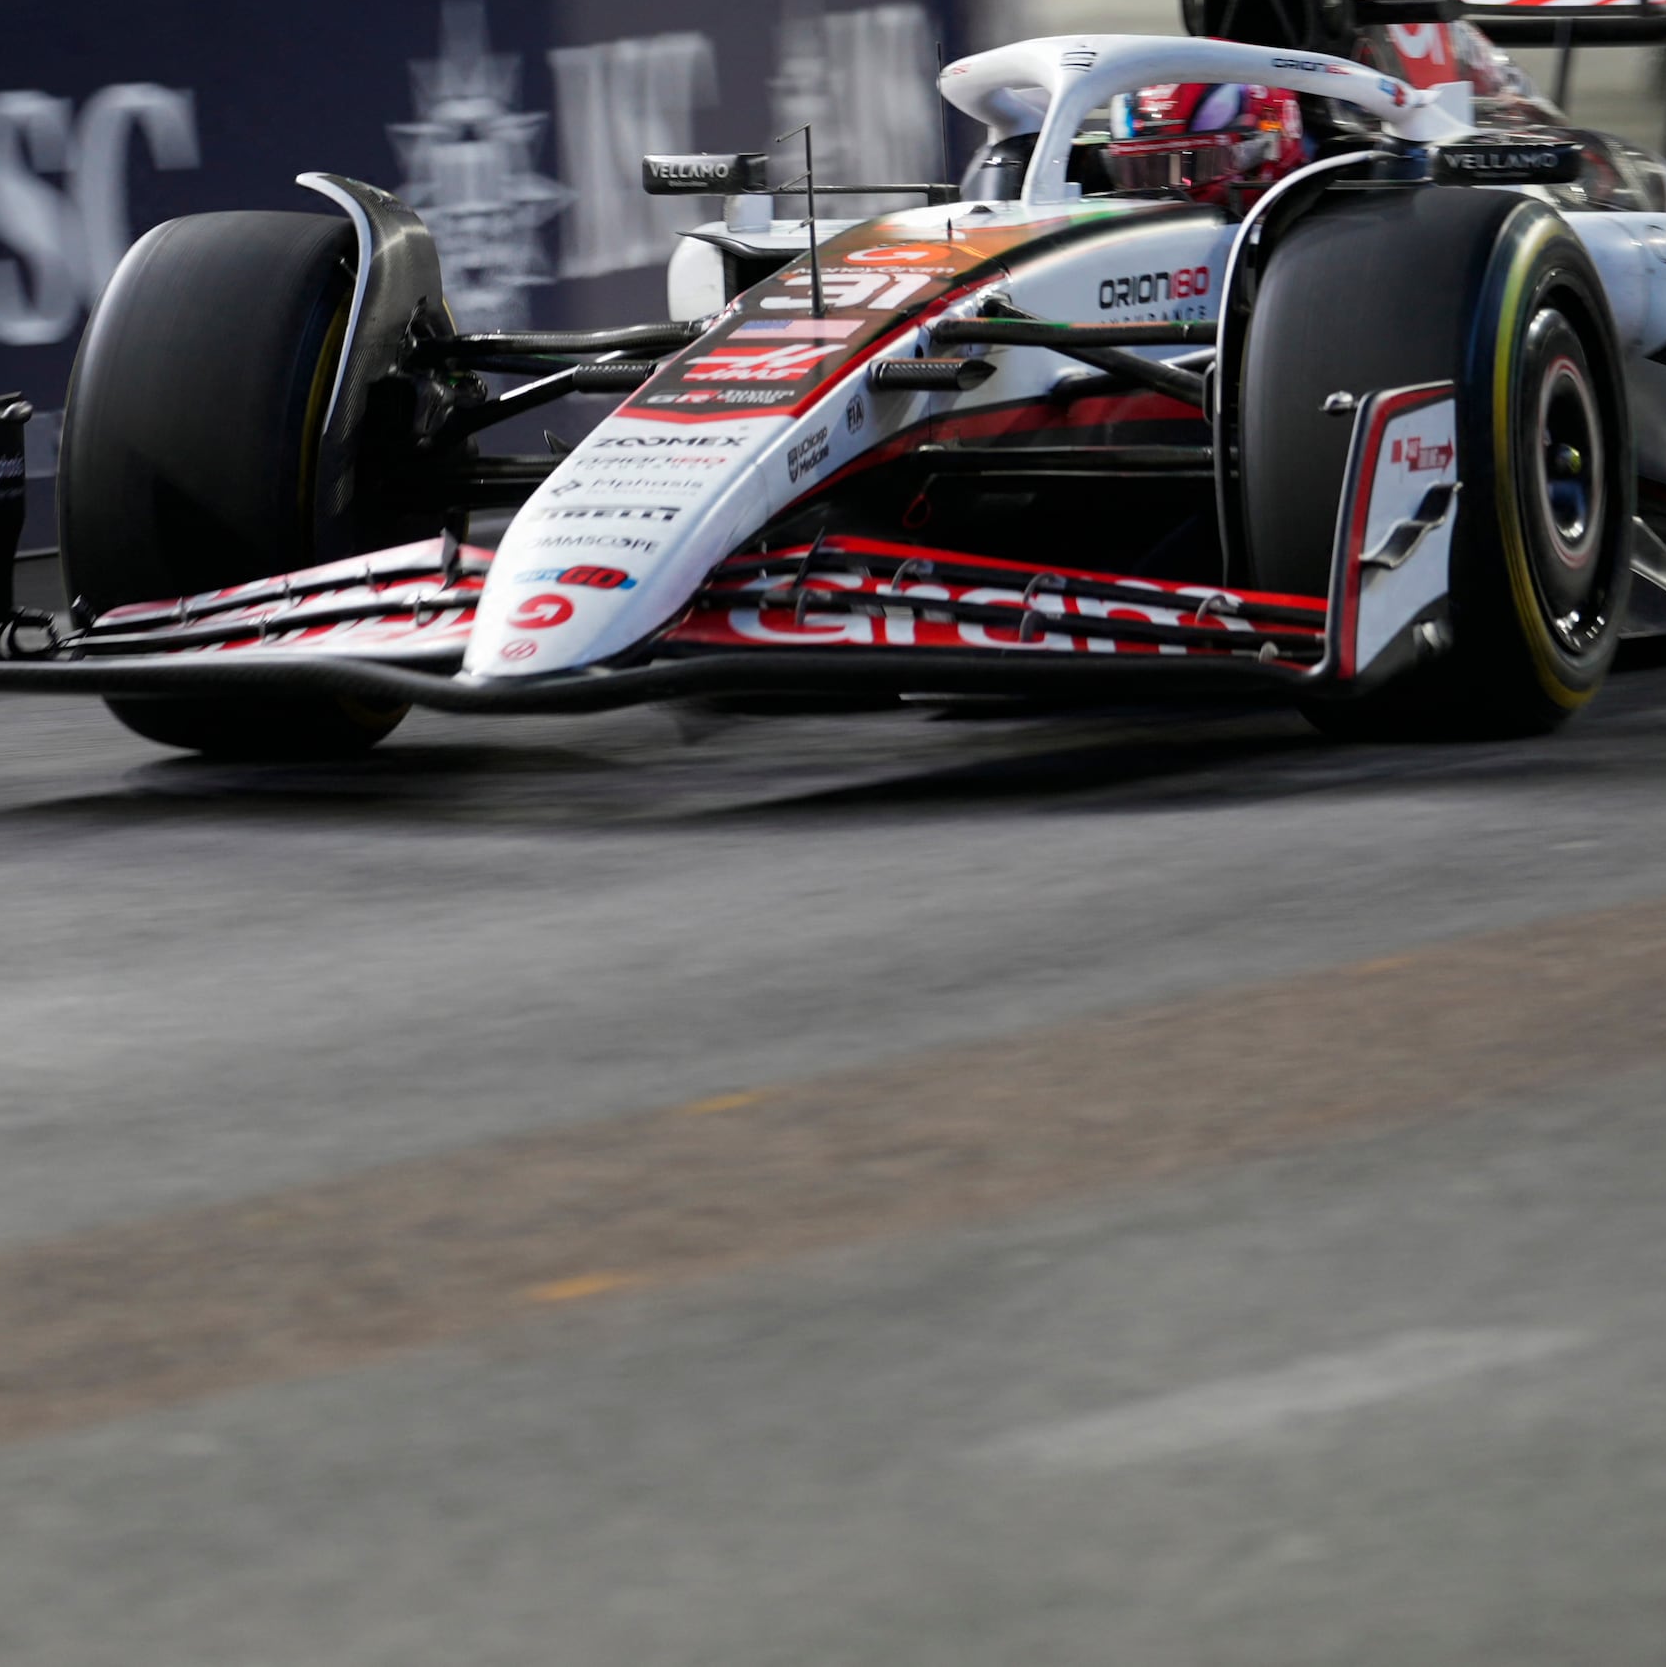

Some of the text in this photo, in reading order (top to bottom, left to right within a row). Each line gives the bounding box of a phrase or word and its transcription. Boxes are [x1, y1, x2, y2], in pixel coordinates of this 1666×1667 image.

[649, 163, 730, 179] VELLAMO
[1445, 152, 1559, 170] VELLAMO
[759, 273, 932, 310] 31
[1099, 266, 1210, 310] ORION180
[847, 400, 864, 432] FIA
[593, 437, 749, 448] ZOOMEX
[526, 534, 660, 554] OMMSCOPE
